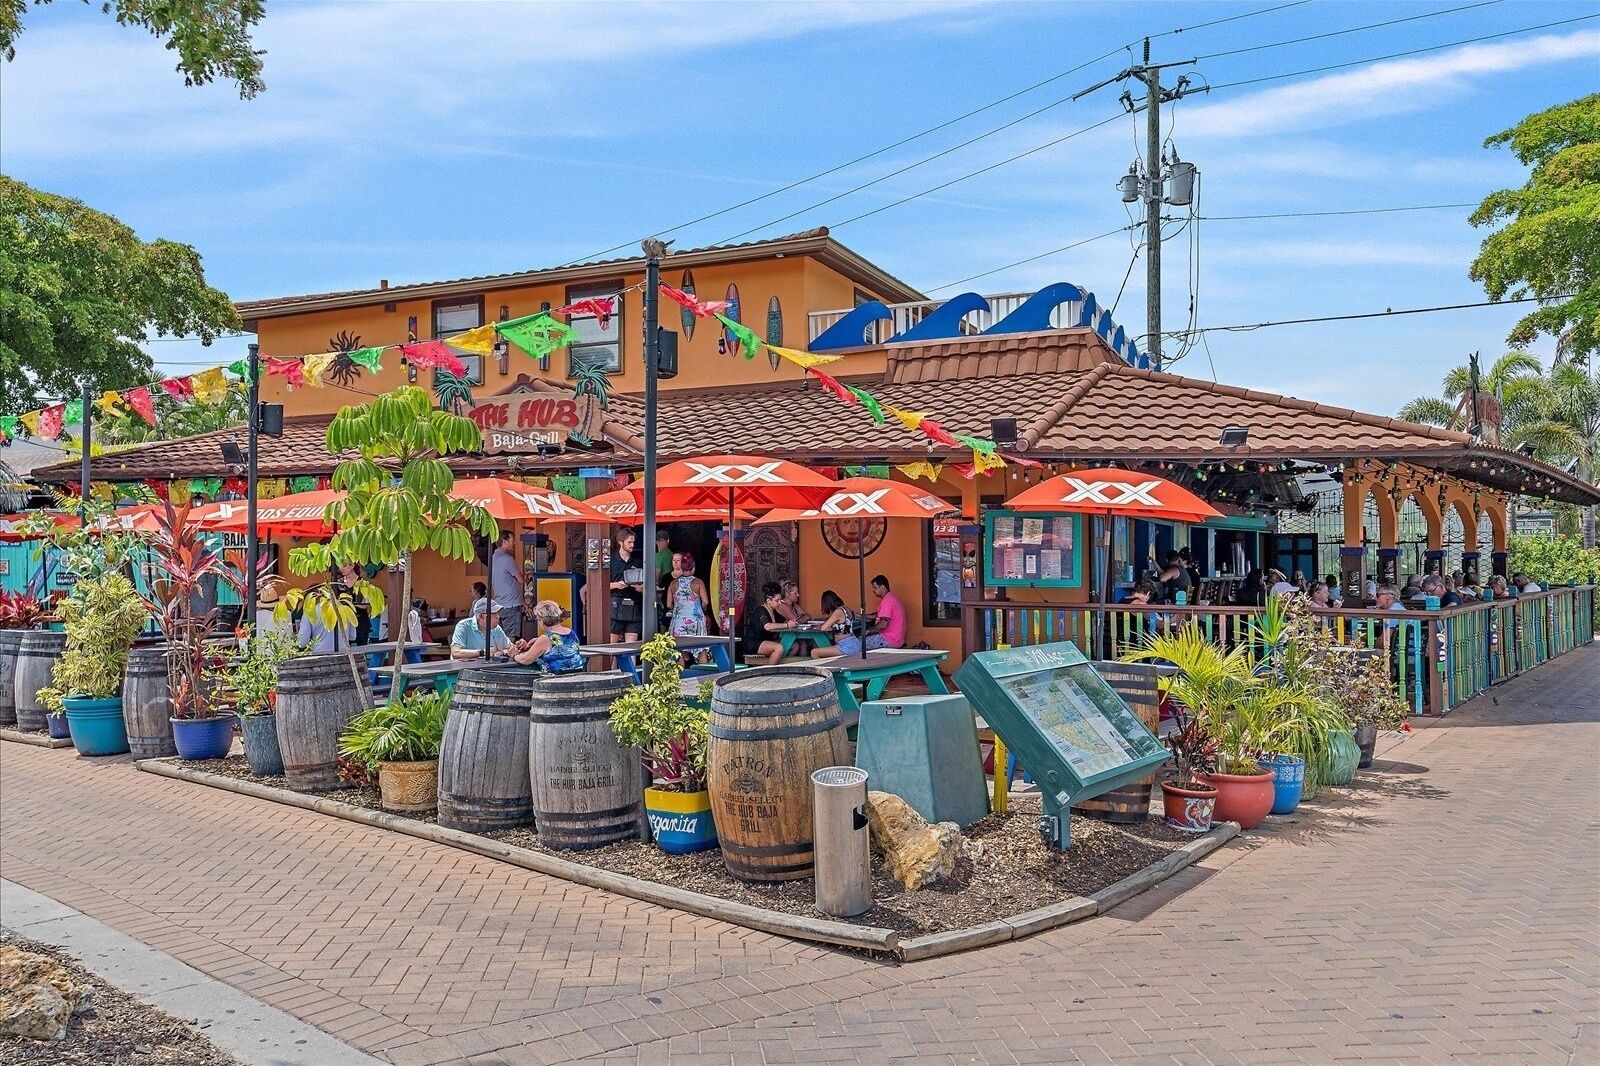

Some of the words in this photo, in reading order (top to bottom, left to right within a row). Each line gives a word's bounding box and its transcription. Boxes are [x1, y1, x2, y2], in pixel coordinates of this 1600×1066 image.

[468, 403, 509, 429] THE
[518, 399, 580, 428] HUB
[492, 431, 559, 449] Baja-Grill
[682, 461, 788, 484] XX
[1059, 476, 1165, 506] XX
[284, 505, 326, 519] EQUI
[605, 502, 637, 515] EQU
[223, 532, 247, 547] BAJA
[550, 778, 561, 790] THE
[578, 778, 596, 790] BAJA
[597, 775, 615, 788] GRILL
[748, 796, 784, 804] SELECT
[724, 801, 737, 816] THE
[738, 804, 755, 818] HUB
[757, 804, 779, 818] BAJA
[740, 819, 762, 833] GRILL
